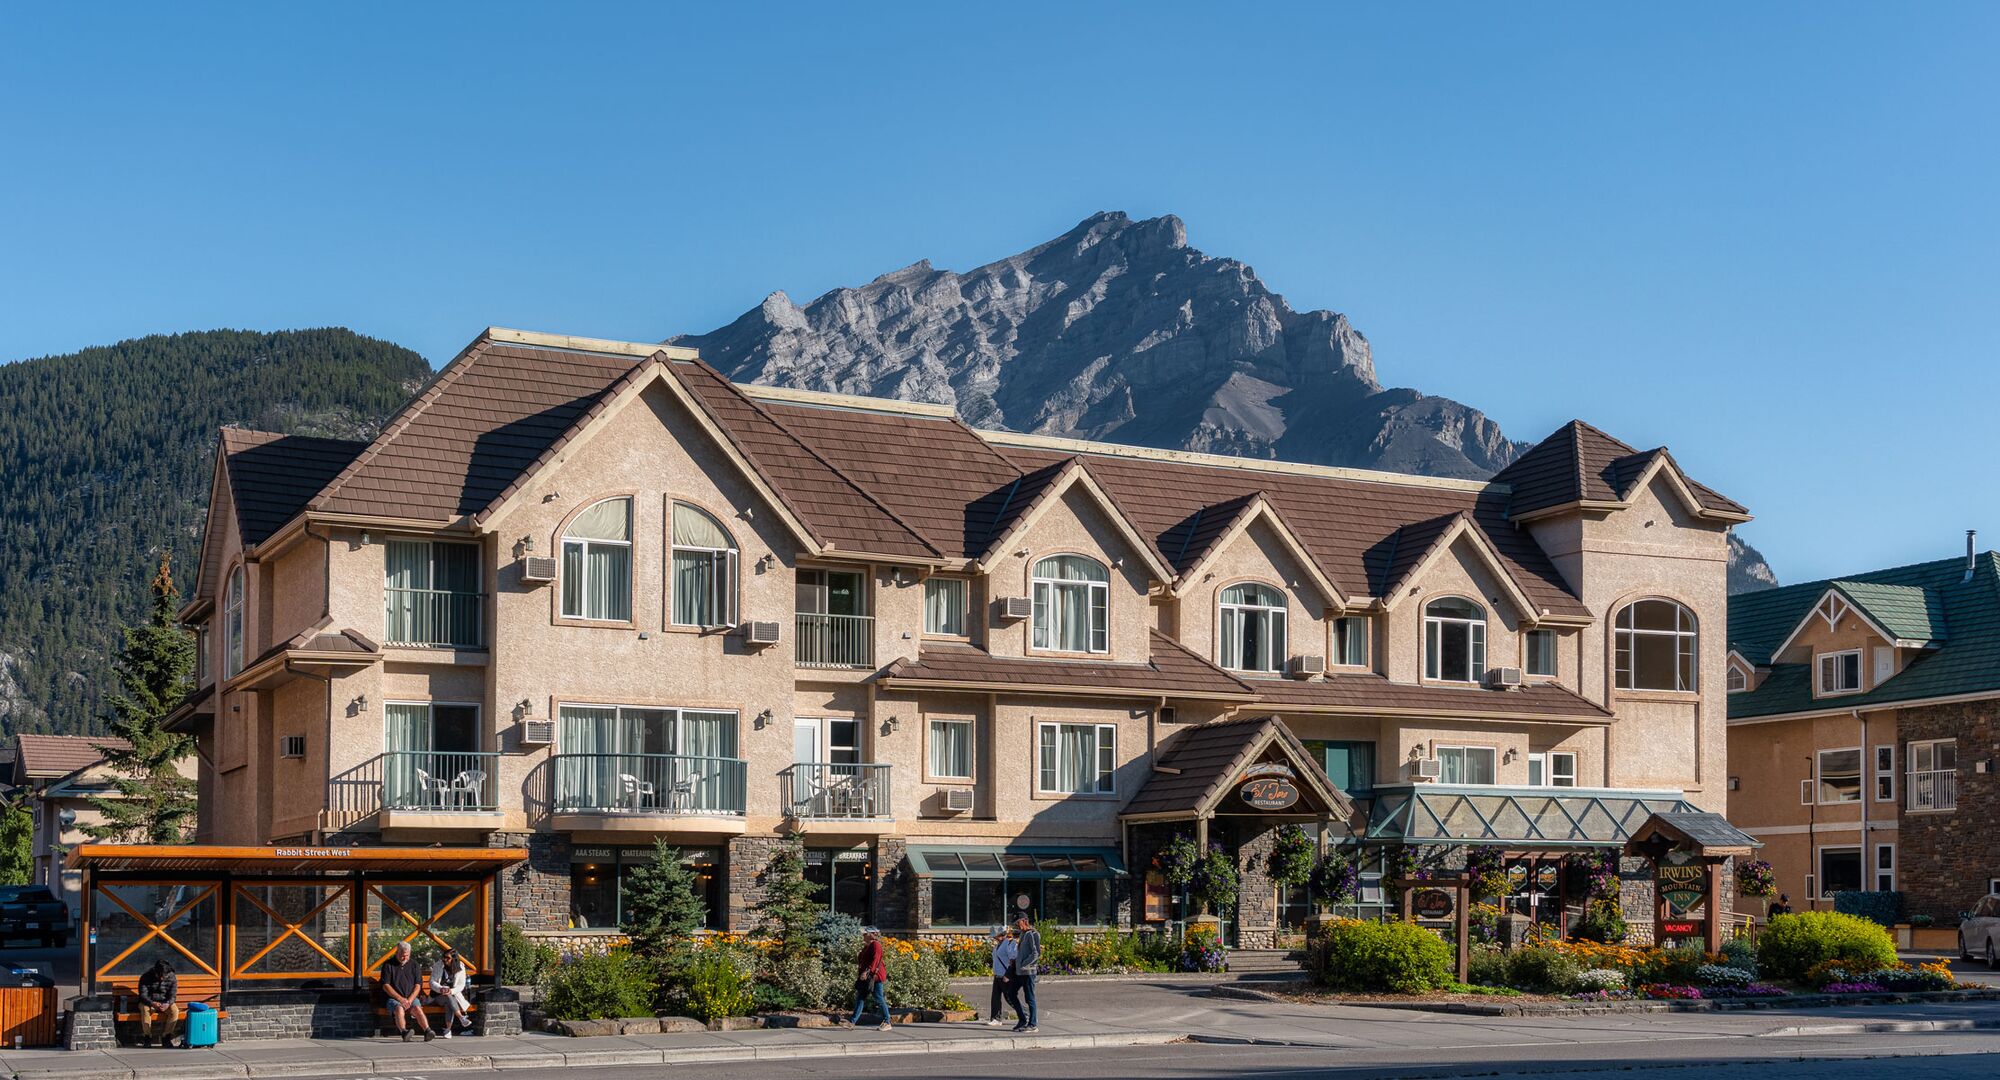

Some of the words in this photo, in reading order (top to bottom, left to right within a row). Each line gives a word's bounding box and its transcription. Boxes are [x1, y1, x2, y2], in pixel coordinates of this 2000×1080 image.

[575, 849, 588, 857] AAA
[588, 849, 610, 857] STEAKS
[1660, 866, 1702, 879] IRWIN'S
[1661, 883, 1701, 893] MOUNTAIN
[1673, 893, 1690, 901] INN
[1664, 924, 1693, 932] VACANCY
